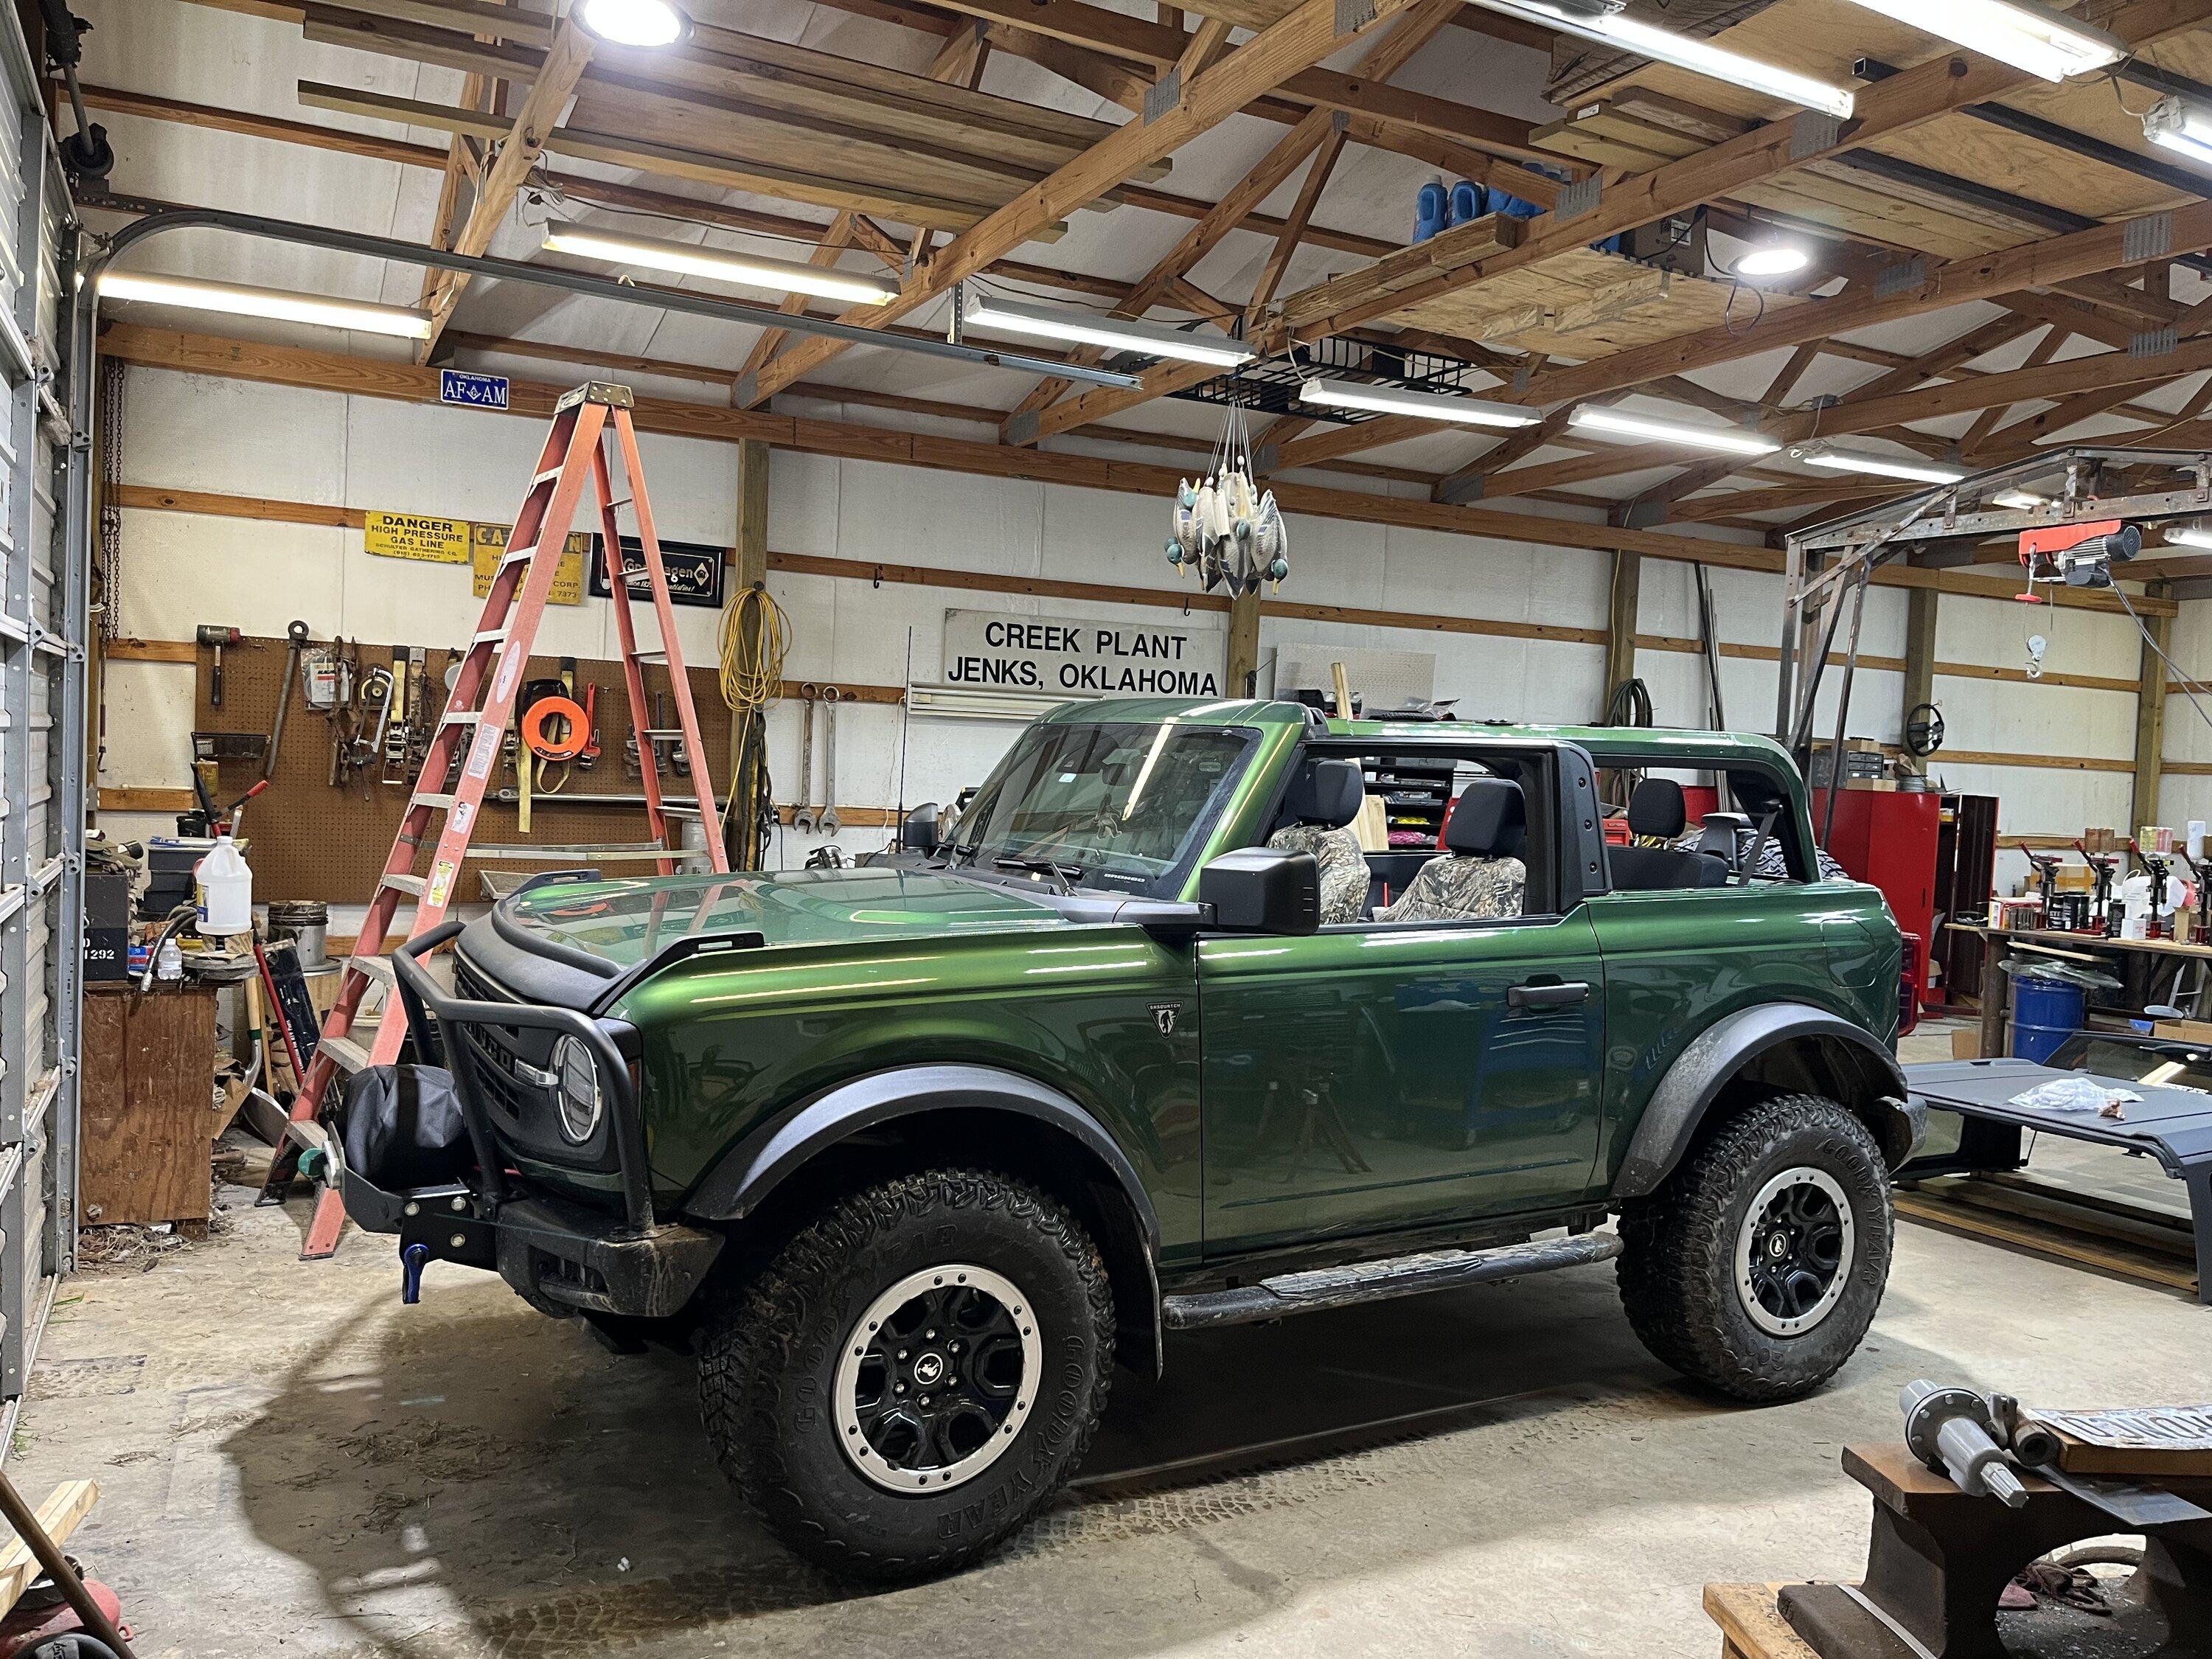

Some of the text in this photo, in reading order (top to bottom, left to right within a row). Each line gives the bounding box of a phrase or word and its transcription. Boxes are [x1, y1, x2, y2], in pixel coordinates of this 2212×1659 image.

[459, 374, 491, 383] OKLAHOMA
[444, 380, 467, 399] AF
[481, 385, 507, 405] AM
[382, 515, 453, 532] DANGER
[371, 525, 399, 535] HIGH
[403, 529, 464, 543] PRESSURE
[391, 536, 445, 549] GAS LINE
[410, 546, 445, 555] GATHERING
[552, 580, 581, 589] CORP.
[557, 590, 577, 599] 7373
[984, 621, 1188, 660] CREEK PLANT
[947, 655, 1219, 697] JENKS, OKLAHOMA
[1103, 873, 1146, 883] BRONCO
